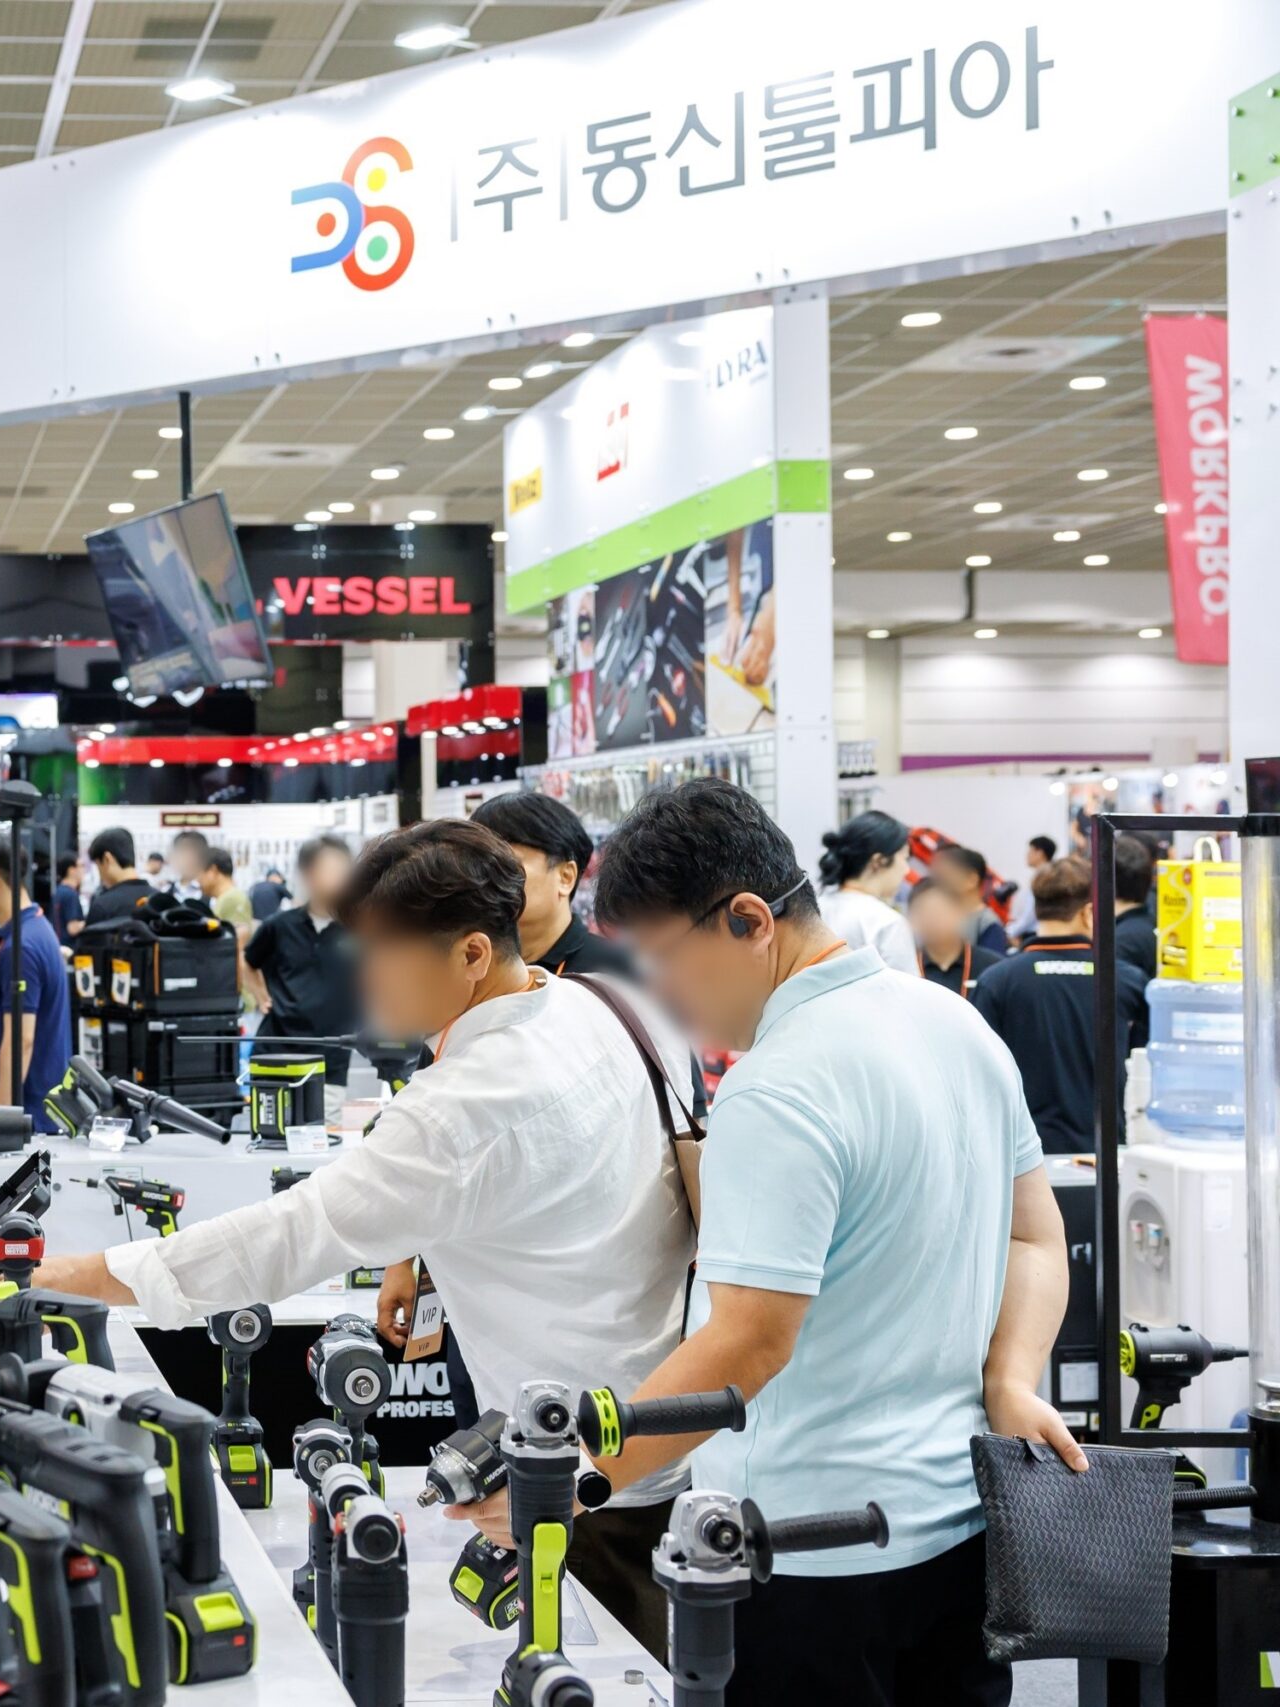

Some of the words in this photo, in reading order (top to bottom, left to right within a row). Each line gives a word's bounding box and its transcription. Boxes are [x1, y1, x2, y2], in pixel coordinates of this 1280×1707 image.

[582, 25, 1055, 215] 동신툴피아
[273, 577, 471, 615] VESSEL
[422, 1306, 437, 1325] VIP
